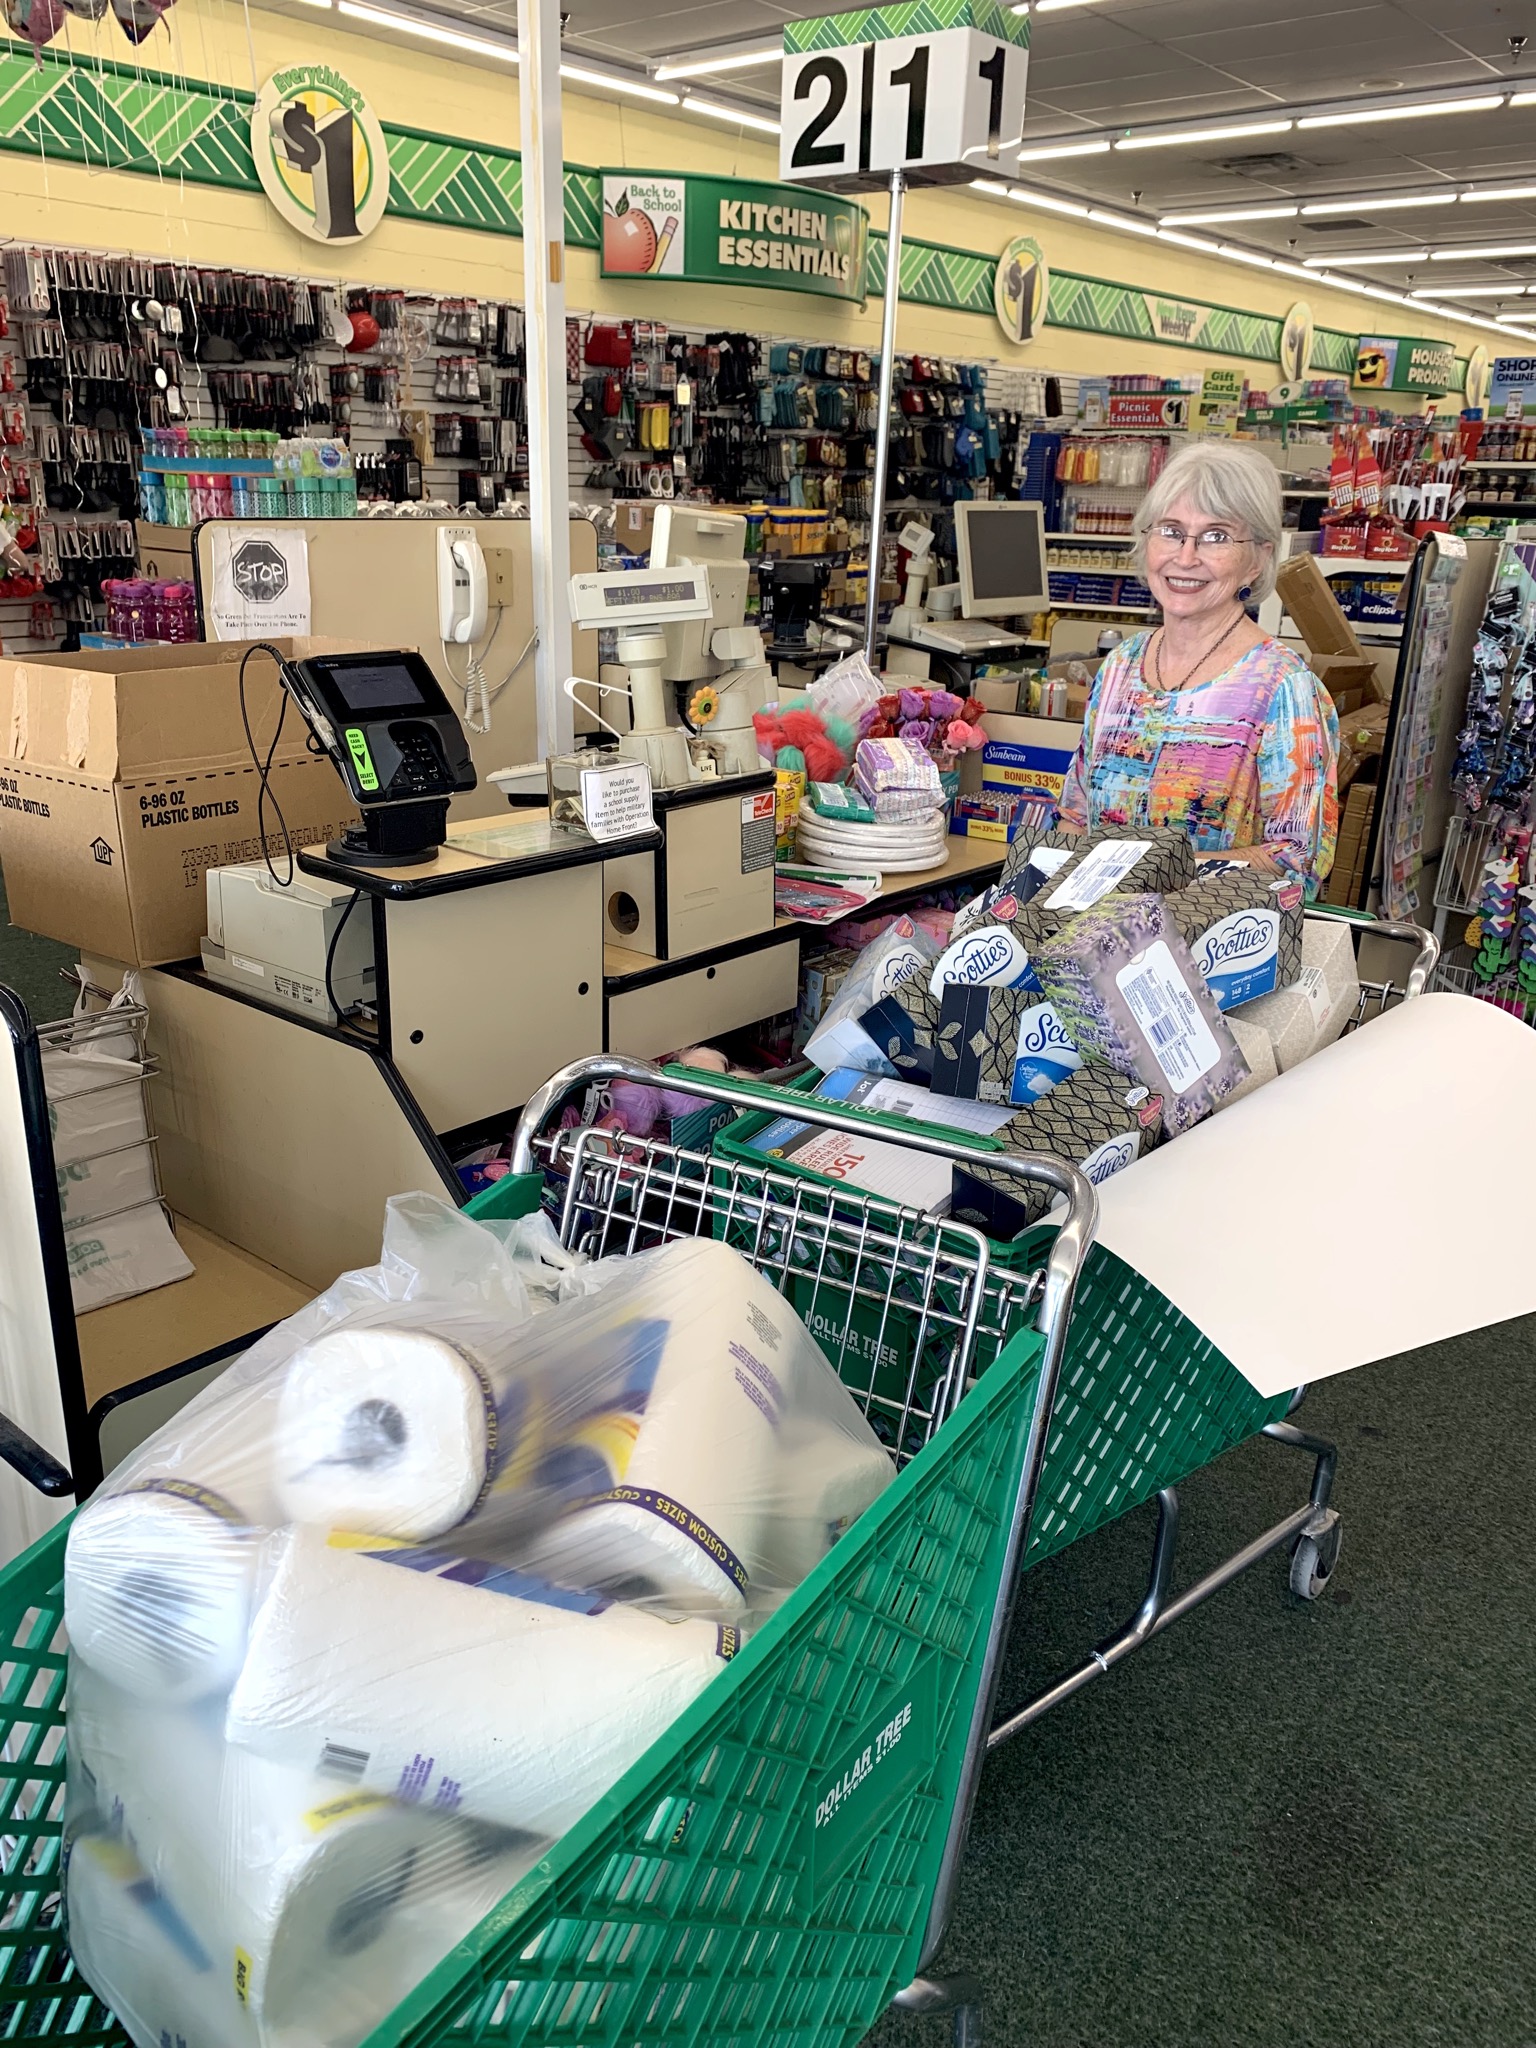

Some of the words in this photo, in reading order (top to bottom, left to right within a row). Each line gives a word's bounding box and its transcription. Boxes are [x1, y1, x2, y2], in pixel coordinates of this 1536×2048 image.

[272, 65, 365, 113] Everything's
[791, 56, 848, 168] 2
[890, 46, 930, 160] 1
[979, 46, 1006, 160] 1
[270, 100, 363, 239] $1
[630, 185, 660, 199] Back
[663, 186, 676, 199] to
[643, 198, 682, 212] School
[719, 199, 827, 241] KITCHEN
[718, 236, 850, 281] ESSENTIALS
[1211, 371, 1234, 382] Gift
[1203, 381, 1241, 392] Cards
[1280, 387, 1290, 399] 9
[1118, 402, 1151, 412] Picnic
[1110, 412, 1160, 423] Essentials
[237, 561, 284, 583] STOP
[617, 588, 640, 597] $1.00
[662, 584, 685, 593] $1.00
[1362, 605, 1397, 615] eclipse
[985, 745, 1026, 762] Sunbeam
[700, 764, 713, 772] LIVE
[10, 779, 19, 794] OZ
[609, 780, 625, 788] Would
[625, 777, 635, 786] you
[1004, 771, 1032, 783] BONUS
[1034, 773, 1061, 790] 33%
[139, 792, 167, 811] 6-96
[170, 790, 186, 806] OZ
[602, 791, 612, 799] like
[619, 786, 640, 798] purchase
[608, 799, 623, 808] school
[623, 794, 640, 805] supply
[24, 803, 50, 819] BOTTLES
[141, 808, 190, 829] PLASTIC
[192, 799, 240, 821] BOTTLES
[591, 819, 613, 828] families
[613, 816, 624, 824] with
[625, 810, 650, 822] Operation
[595, 810, 610, 818] item
[615, 806, 626, 815] help
[626, 802, 645, 813] military
[606, 826, 621, 835] Home
[622, 822, 638, 832] Front?
[96, 845, 108, 860] UP
[1198, 926, 1269, 977] Scotties
[1231, 973, 1253, 987] everyday
[1253, 966, 1271, 978] comfort
[1231, 987, 1242, 996] 148
[770, 1085, 814, 1100] TREE
[815, 1096, 883, 1116] DOLLAR
[823, 1153, 865, 1179] 150
[804, 1310, 859, 1347] DOLLAR
[862, 1335, 899, 1366] TREE
[812, 1329, 830, 1342] ALL
[832, 1338, 861, 1355] ITMS
[655, 1497, 688, 1525] SIZES
[688, 1518, 728, 1562] CUSTOM
[722, 1626, 736, 1659] SIZES
[815, 1745, 872, 1829] DOLLAR
[875, 1701, 912, 1755] TREE
[822, 1803, 841, 1828] ALL
[843, 1763, 874, 1801] ITEMS
[875, 1732, 902, 1764] $1.00
